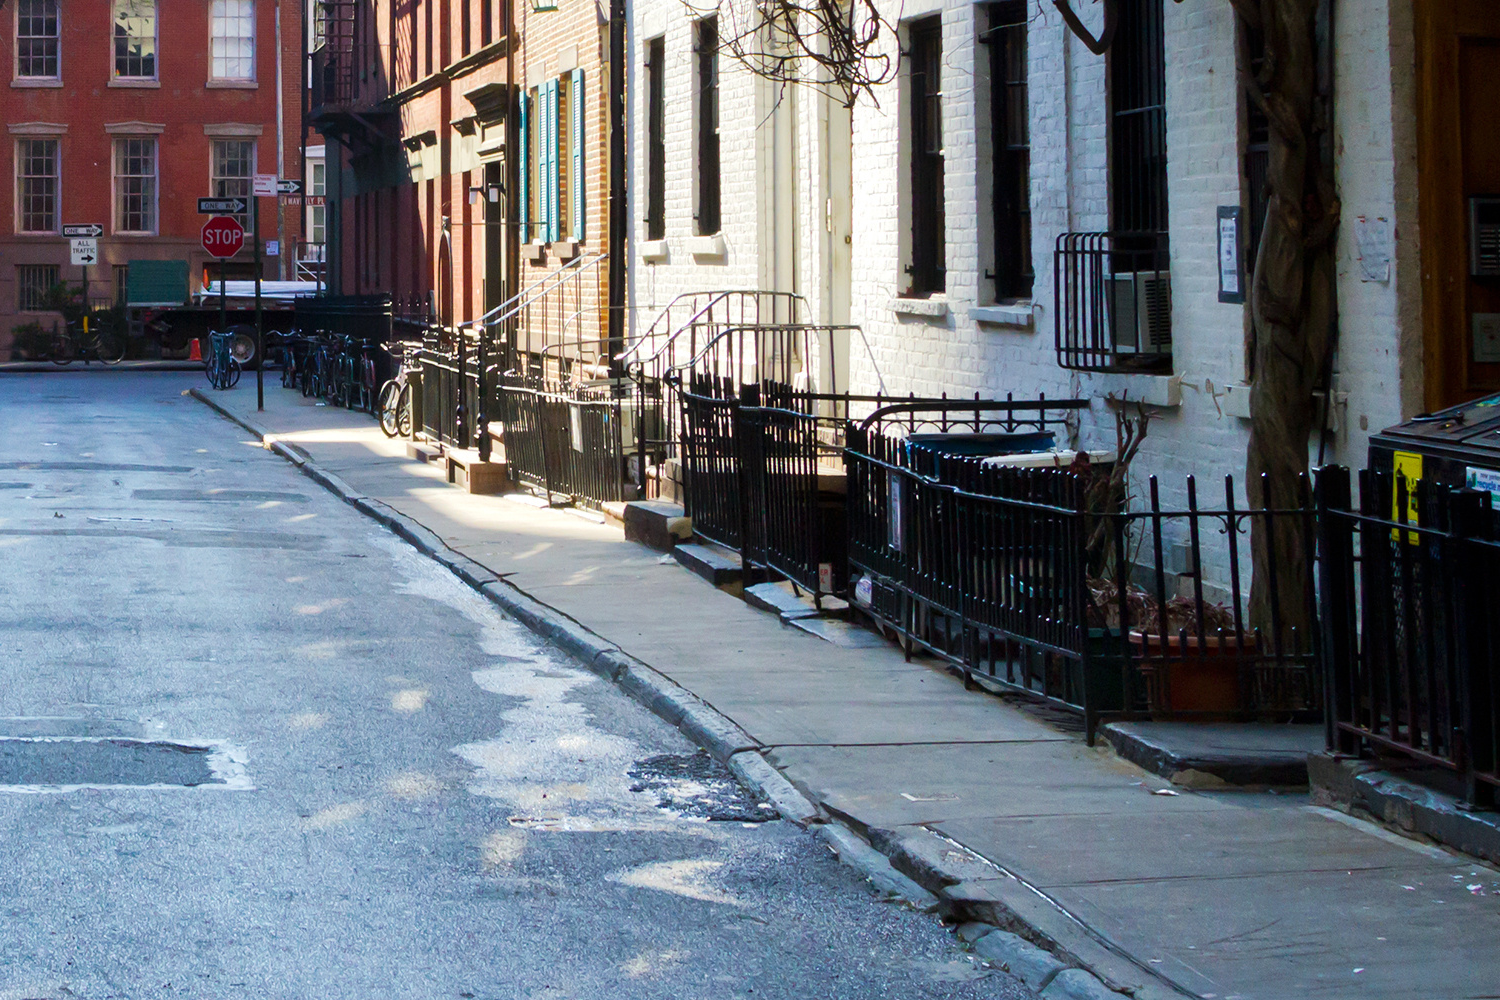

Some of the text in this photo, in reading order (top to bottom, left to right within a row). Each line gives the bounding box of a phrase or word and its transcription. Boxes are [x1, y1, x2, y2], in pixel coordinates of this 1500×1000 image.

[204, 202, 241, 210] ONE WAY
[287, 196, 324, 206] WAVLY PL
[205, 229, 241, 245] STOP
